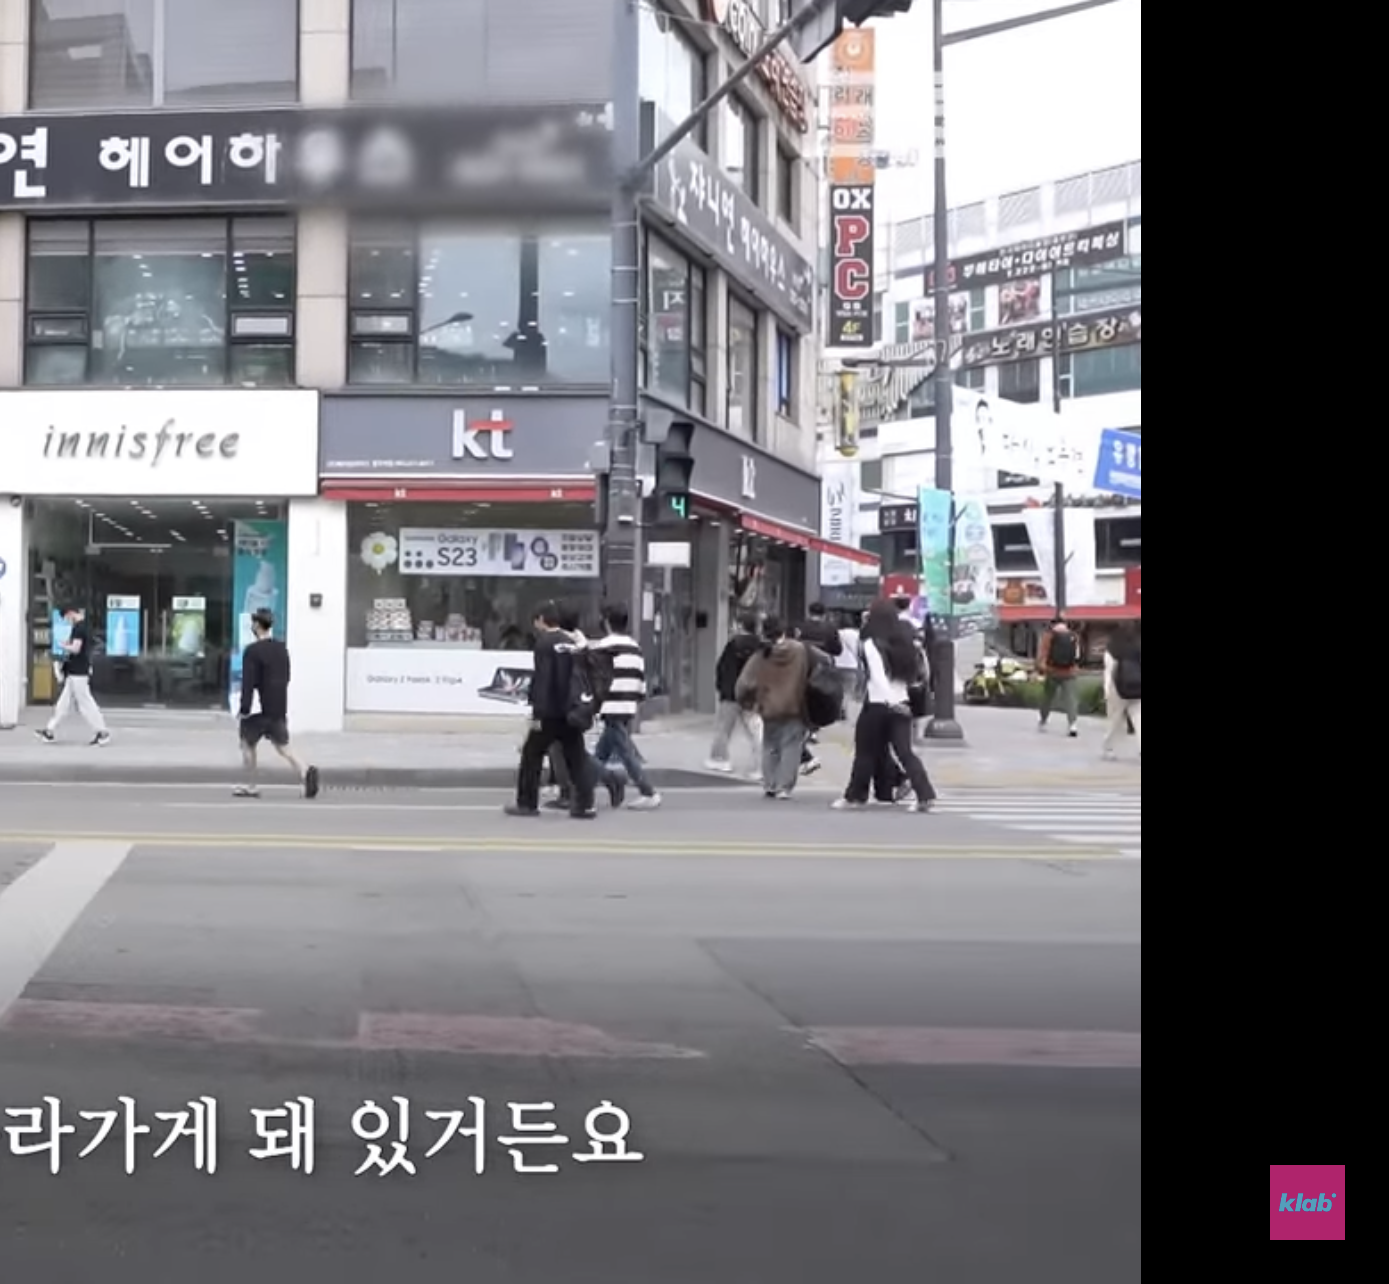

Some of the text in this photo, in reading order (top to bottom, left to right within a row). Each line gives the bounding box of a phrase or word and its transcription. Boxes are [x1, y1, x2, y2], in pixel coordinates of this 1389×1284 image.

[98, 133, 411, 188] 헤어하
[689, 151, 735, 256] 쟈니연
[833, 187, 871, 209] OX
[834, 215, 870, 300] PC
[42, 418, 241, 466] innisfree
[452, 409, 515, 458] kt
[671, 496, 685, 518] 4
[437, 547, 478, 566] S23
